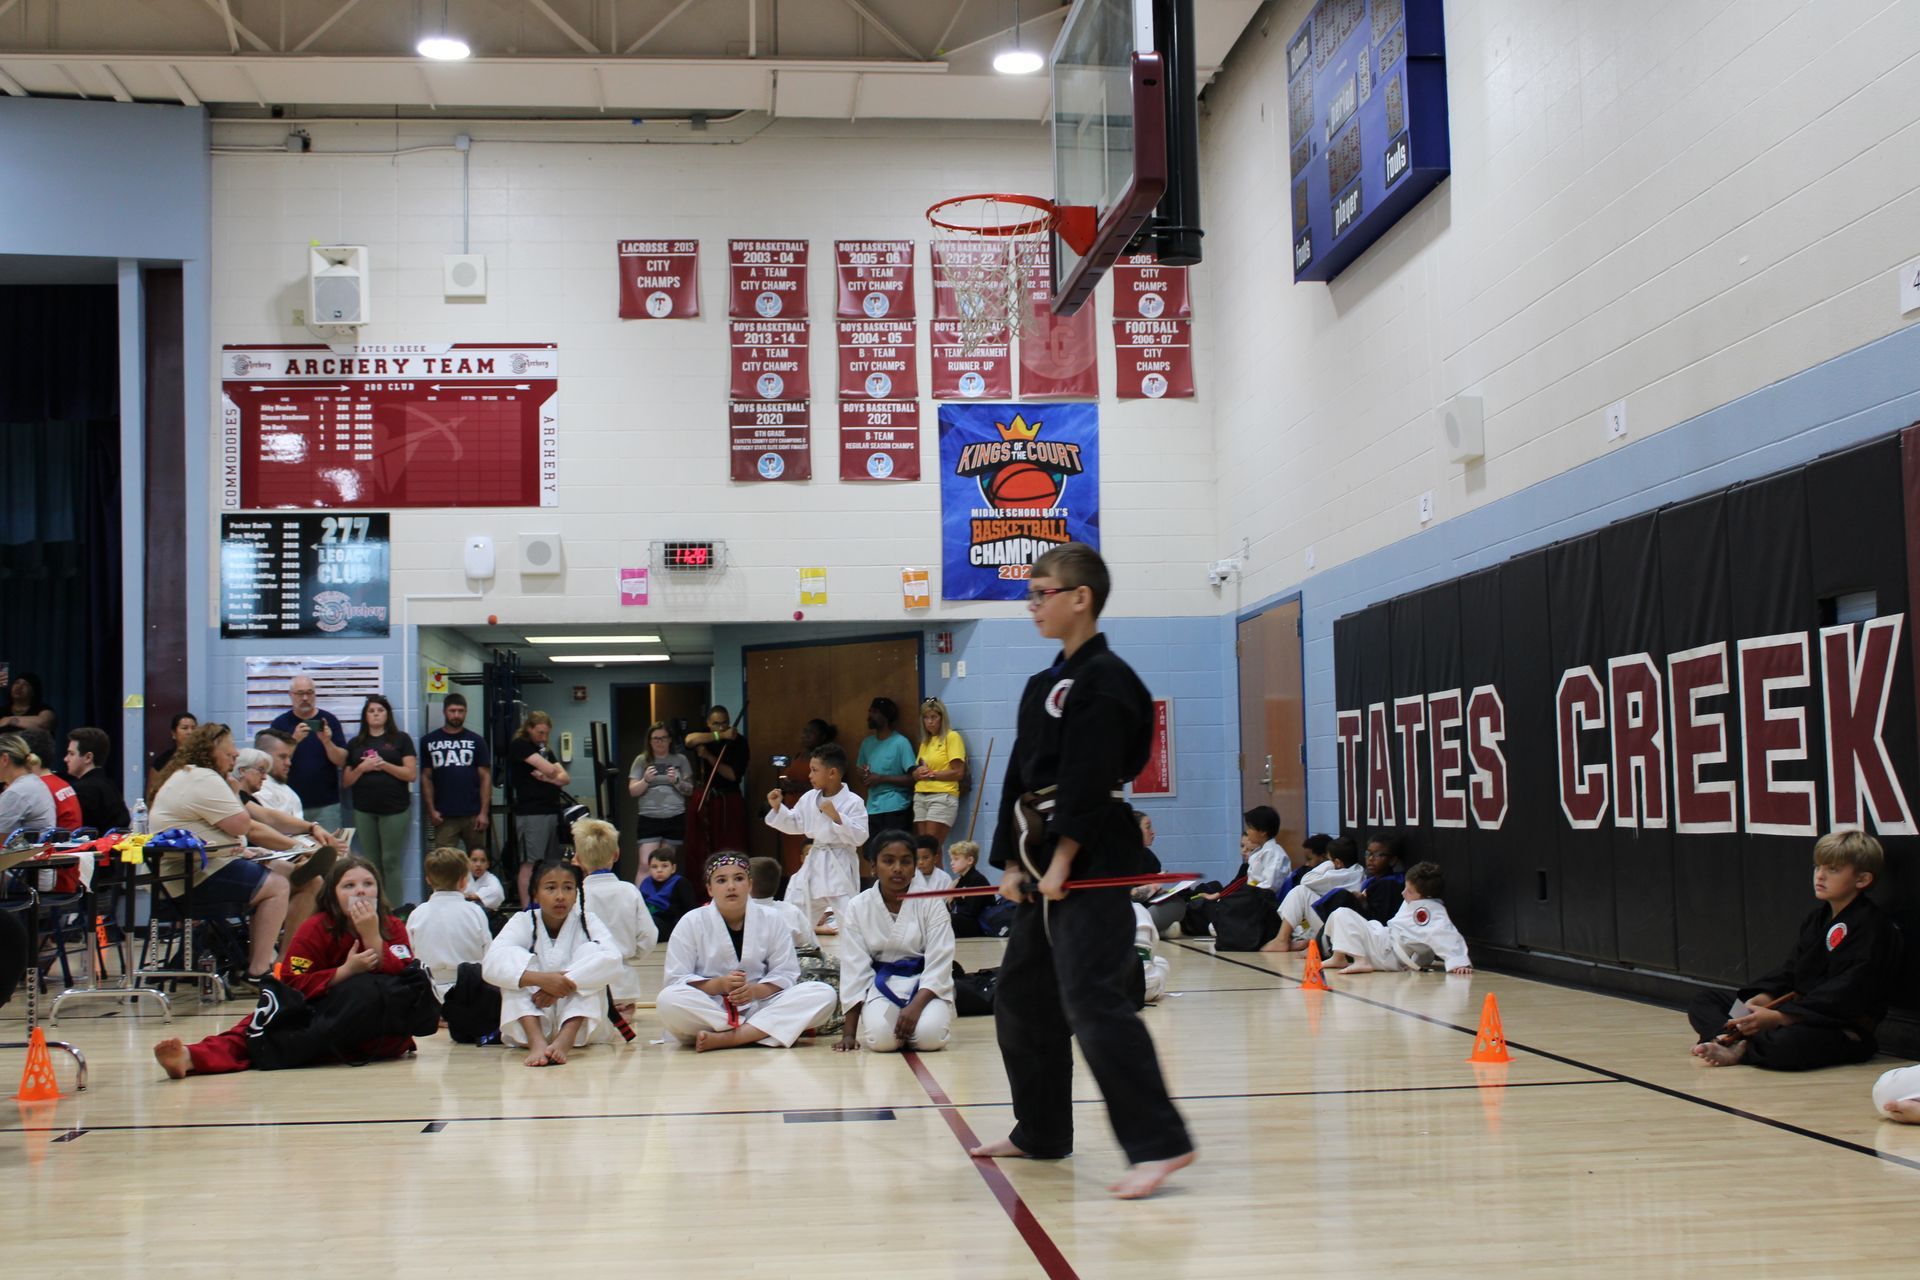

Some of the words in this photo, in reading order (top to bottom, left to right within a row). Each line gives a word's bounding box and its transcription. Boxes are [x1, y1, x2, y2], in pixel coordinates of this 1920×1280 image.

[1331, 80, 1354, 133] period
[1386, 142, 1407, 182] fouls
[1336, 189, 1359, 236] player
[622, 242, 669, 253] LACROSSE
[674, 242, 694, 252] 2013
[732, 242, 753, 252] BOYS
[755, 242, 804, 252] BASKETBALL
[838, 242, 860, 252] BOYS
[862, 242, 911, 252] BASKETBALL
[743, 252, 771, 264] 2003
[780, 252, 794, 264] 04
[849, 252, 877, 264] 2005
[1296, 236, 1310, 271] fouls
[1130, 255, 1152, 264] 2005
[646, 260, 670, 272] CITY
[764, 268, 787, 278] TEAM
[870, 268, 893, 278] TEAM
[1140, 268, 1160, 278] CITY
[637, 276, 681, 288] CHAMPS
[740, 281, 759, 291] CITY
[762, 281, 797, 291] CHAMPS
[848, 281, 866, 291] CITY
[868, 281, 903, 291] CHAMPS
[1134, 281, 1167, 291] CHAMPS
[734, 322, 755, 332] BOYS
[757, 322, 806, 332] BASKETBALL
[841, 322, 862, 332] BOYS
[864, 322, 912, 332] BASKETBALL
[935, 322, 955, 331] BOYS
[1126, 321, 1179, 334] FOOTBALL
[744, 332, 772, 344] 2013
[781, 332, 796, 344] 14
[852, 332, 879, 344] 2004
[888, 332, 902, 344] 05
[1132, 335, 1154, 344] 2006
[1162, 335, 1172, 344] 07
[765, 348, 788, 358] TEAM
[873, 348, 896, 358] TEAM
[1144, 348, 1162, 358] CITY
[285, 358, 409, 375] ARCHERY
[424, 358, 494, 374] TEAM
[742, 362, 761, 371] CITY
[763, 362, 798, 371] CHAMPS
[850, 361, 869, 371] CITY
[871, 361, 906, 371] CHAMPS
[948, 361, 980, 370] RUNNER
[983, 361, 994, 370] UP
[1136, 361, 1170, 371] CHAMPS
[734, 403, 755, 412] BOYS
[757, 403, 806, 412] BASKETBALL
[844, 403, 865, 412] BOYS
[866, 403, 915, 412] BASKETBALL
[756, 413, 784, 425] 2020
[868, 413, 892, 425] 2021
[1613, 415, 1620, 433] 3
[874, 432, 894, 440] TEAM
[1014, 442, 1023, 451] OF
[226, 408, 238, 507] COMMODORES
[543, 416, 555, 493] ARCHERY
[956, 442, 1012, 474] KINGS
[1011, 450, 1027, 460] THE
[1026, 442, 1082, 473] COURT
[1423, 498, 1428, 513] 2
[971, 508, 1004, 518] MIDDLE
[1006, 508, 1040, 518] SCHOOL
[1042, 508, 1068, 518] BOY'S
[320, 517, 370, 544] 277
[972, 519, 1070, 544] BASKETBALL
[318, 564, 371, 584] CLUB
[342, 601, 386, 621] Archery
[1336, 684, 1508, 830] TATES
[1556, 612, 1919, 836] CREEK
[428, 740, 475, 752] KARATE
[431, 749, 473, 768] DAD
